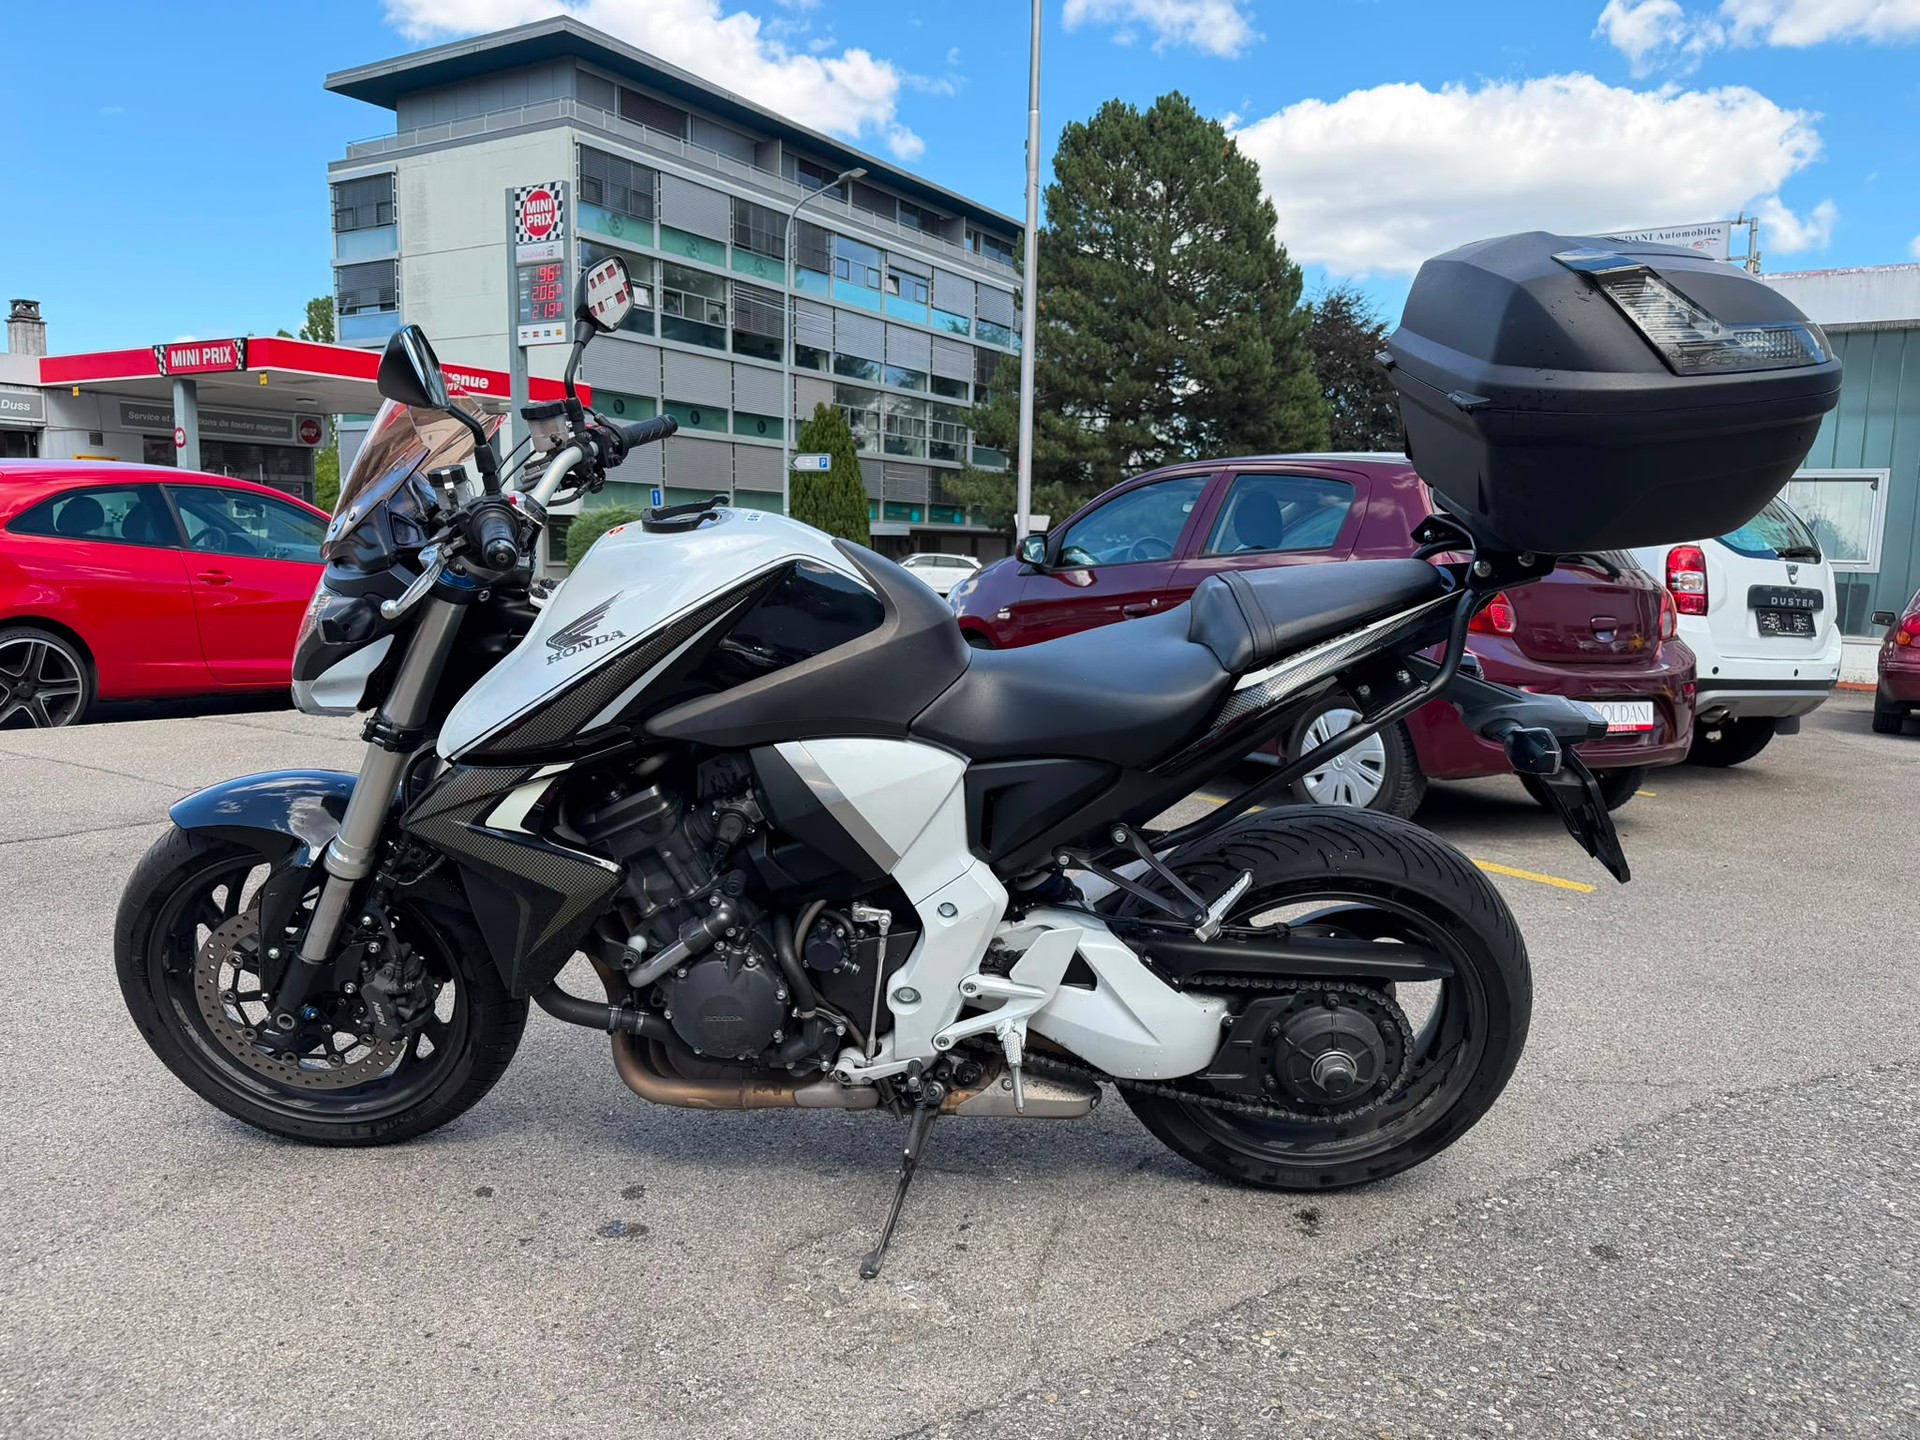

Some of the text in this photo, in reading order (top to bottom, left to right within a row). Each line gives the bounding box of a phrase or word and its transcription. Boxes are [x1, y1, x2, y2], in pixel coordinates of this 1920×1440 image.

[526, 198, 552, 214] MINI
[526, 212, 553, 228] PRIX
[1656, 227, 1721, 240] Automobiles
[171, 346, 232, 367] MINI PRIX
[0, 399, 30, 411] Duss
[128, 411, 160, 422] Service
[161, 414, 171, 422] et
[218, 419, 229, 428] de
[230, 420, 255, 430] toutes
[1771, 596, 1815, 607] DUSTER
[546, 630, 627, 666] HONDA
